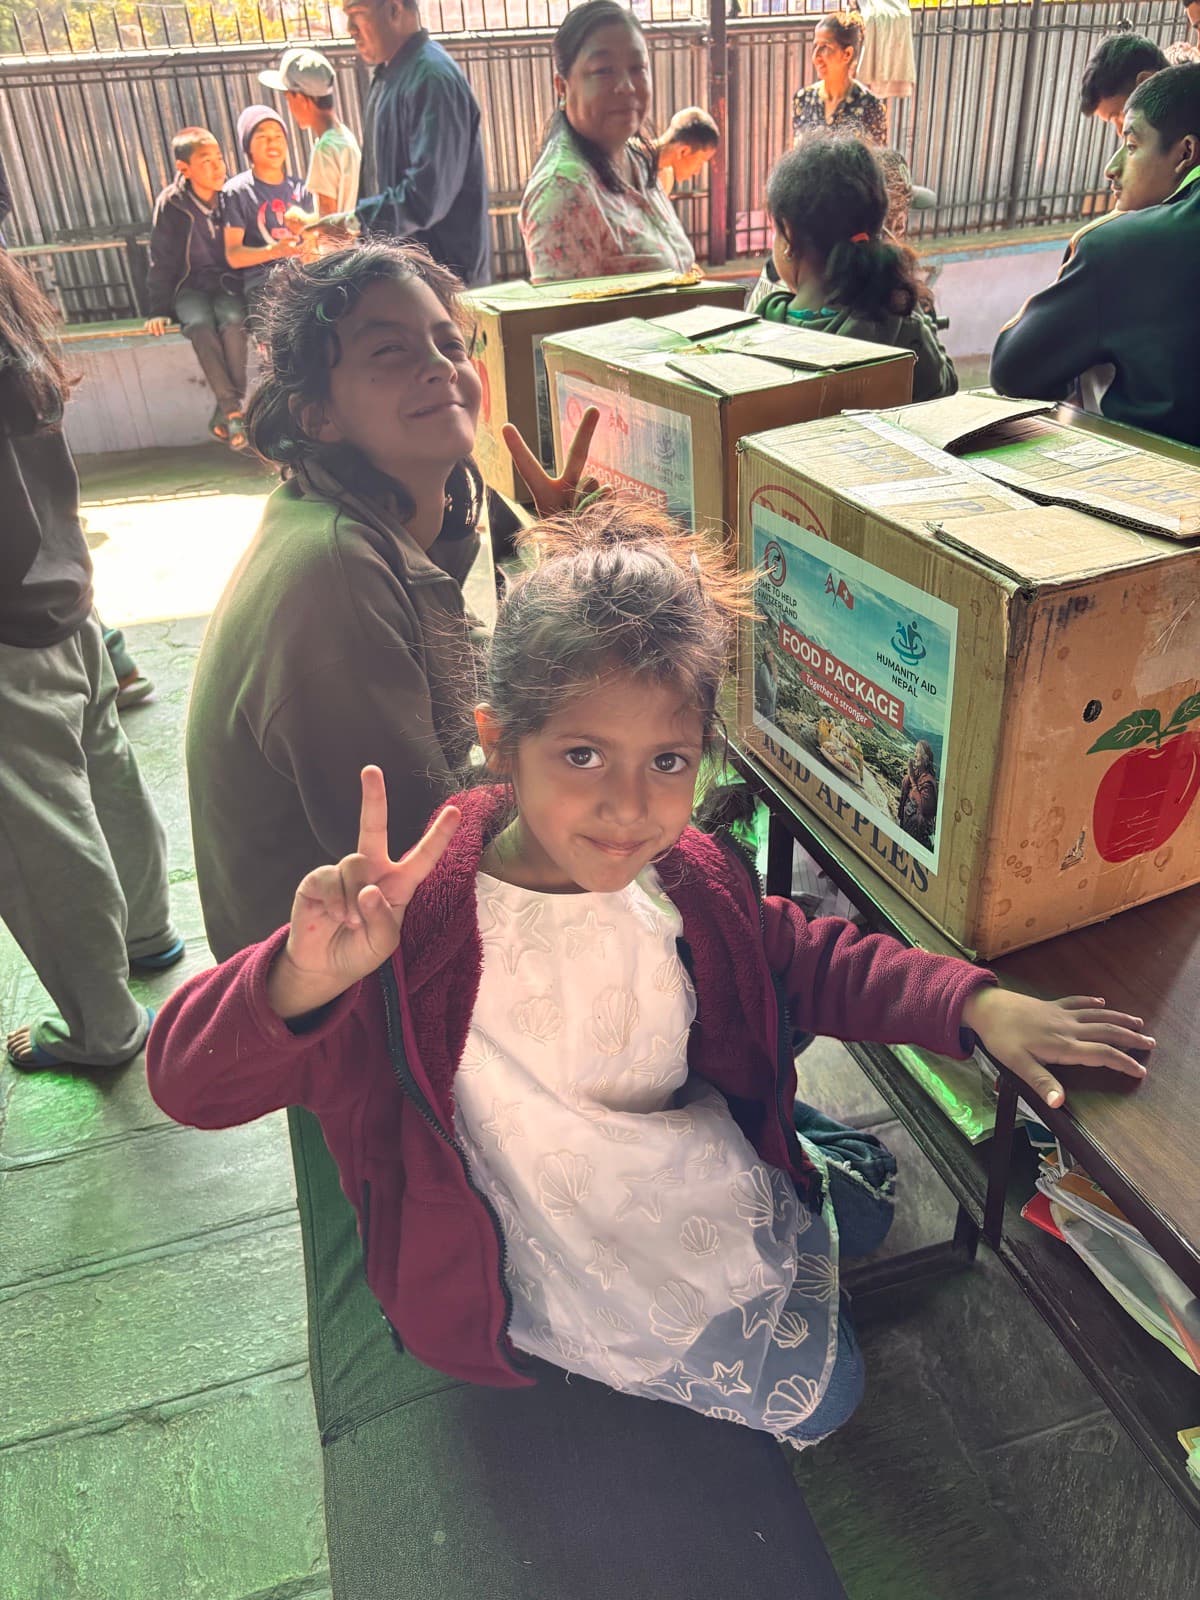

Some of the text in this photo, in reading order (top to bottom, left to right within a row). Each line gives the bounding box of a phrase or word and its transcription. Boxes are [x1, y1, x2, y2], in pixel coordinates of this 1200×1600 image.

[771, 585, 781, 598] TO
[781, 591, 798, 608] HELP
[782, 628, 899, 723] FOOD PACKAGE
[876, 651, 937, 696] HUMANITY AID
[891, 674, 918, 698] NEPAL
[806, 674, 868, 724] Together is stronger
[816, 782, 929, 893] APPLES
